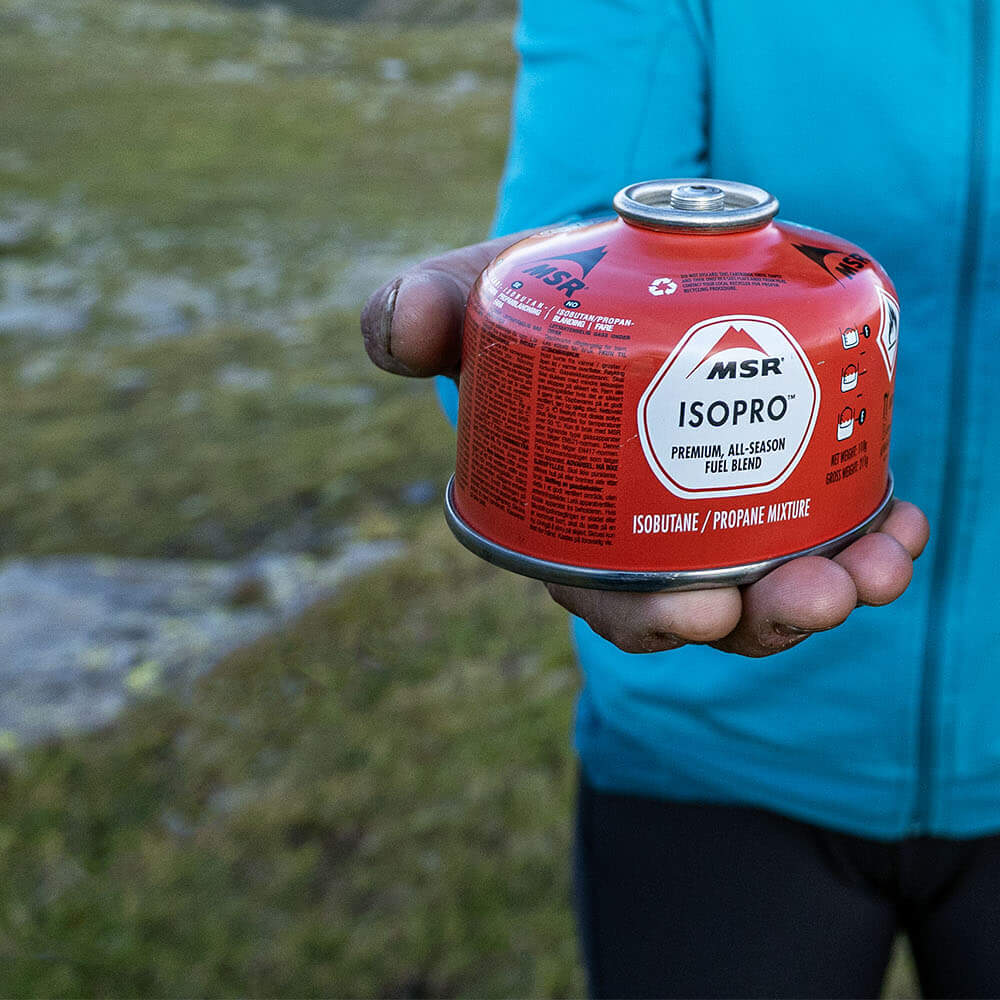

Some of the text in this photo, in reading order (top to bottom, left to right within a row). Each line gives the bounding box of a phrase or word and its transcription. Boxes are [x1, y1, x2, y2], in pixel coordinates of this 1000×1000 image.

[835, 253, 871, 280] MSR
[522, 264, 586, 298] MSR
[706, 357, 783, 380] MSR
[671, 438, 786, 459] PREMIUM, ALL-SEASON
[705, 457, 762, 474] FUEL BLEND
[632, 498, 811, 534] ISOBUTANE / PROPANE MIXTURE
